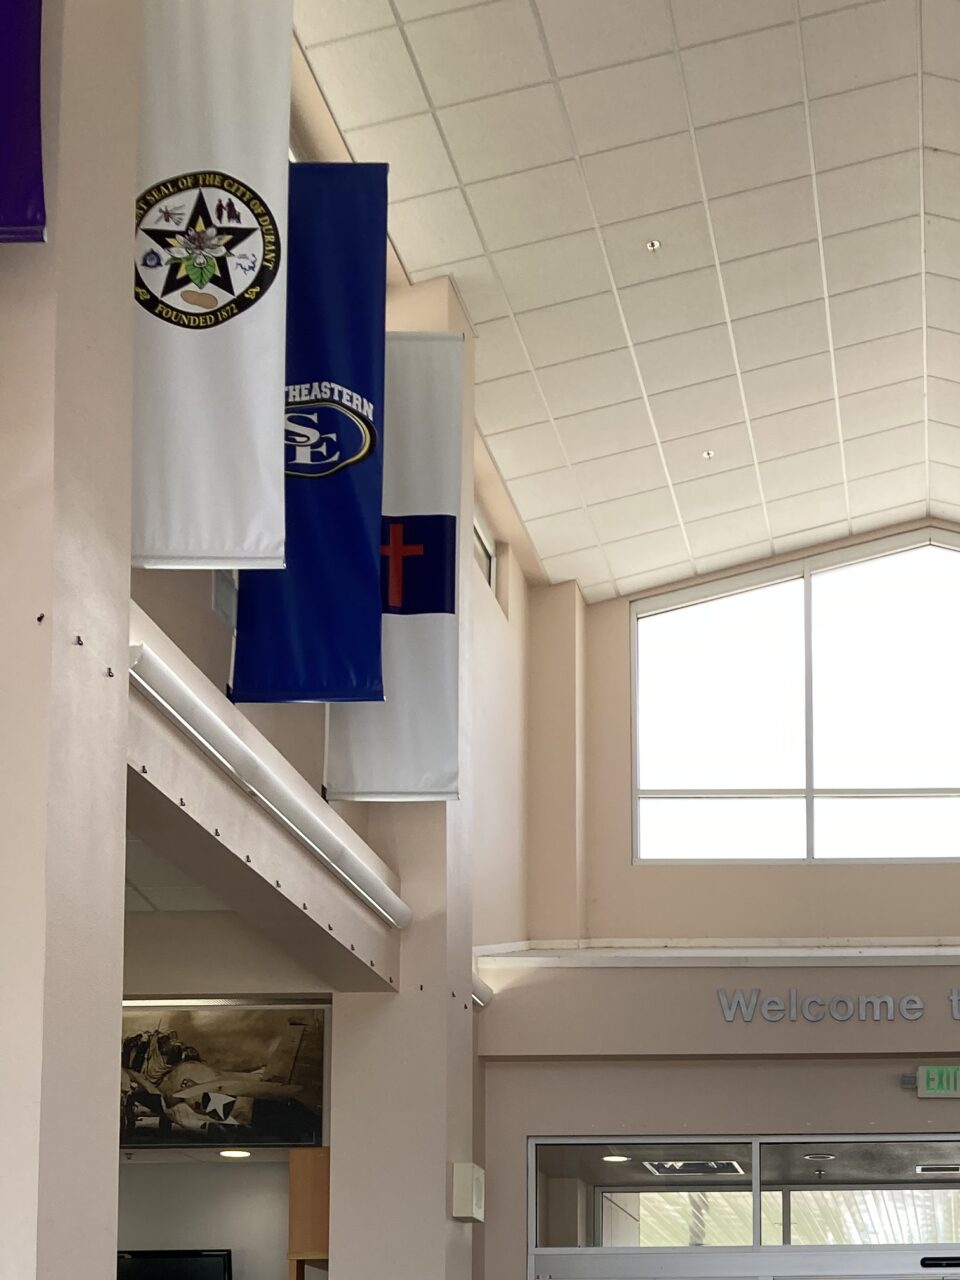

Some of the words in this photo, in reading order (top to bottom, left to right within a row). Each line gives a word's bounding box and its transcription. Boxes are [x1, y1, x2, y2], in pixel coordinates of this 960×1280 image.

[146, 184, 177, 202] SEAL
[179, 175, 195, 188] OF
[197, 174, 223, 185] THE
[223, 179, 249, 202] CITY
[249, 199, 266, 214] OF
[259, 216, 277, 270] DURANT
[155, 304, 215, 327] FOUNDED
[217, 304, 238, 322] 1872
[717, 988, 924, 1022] Welcome
[925, 1066, 960, 1091] EXIT
